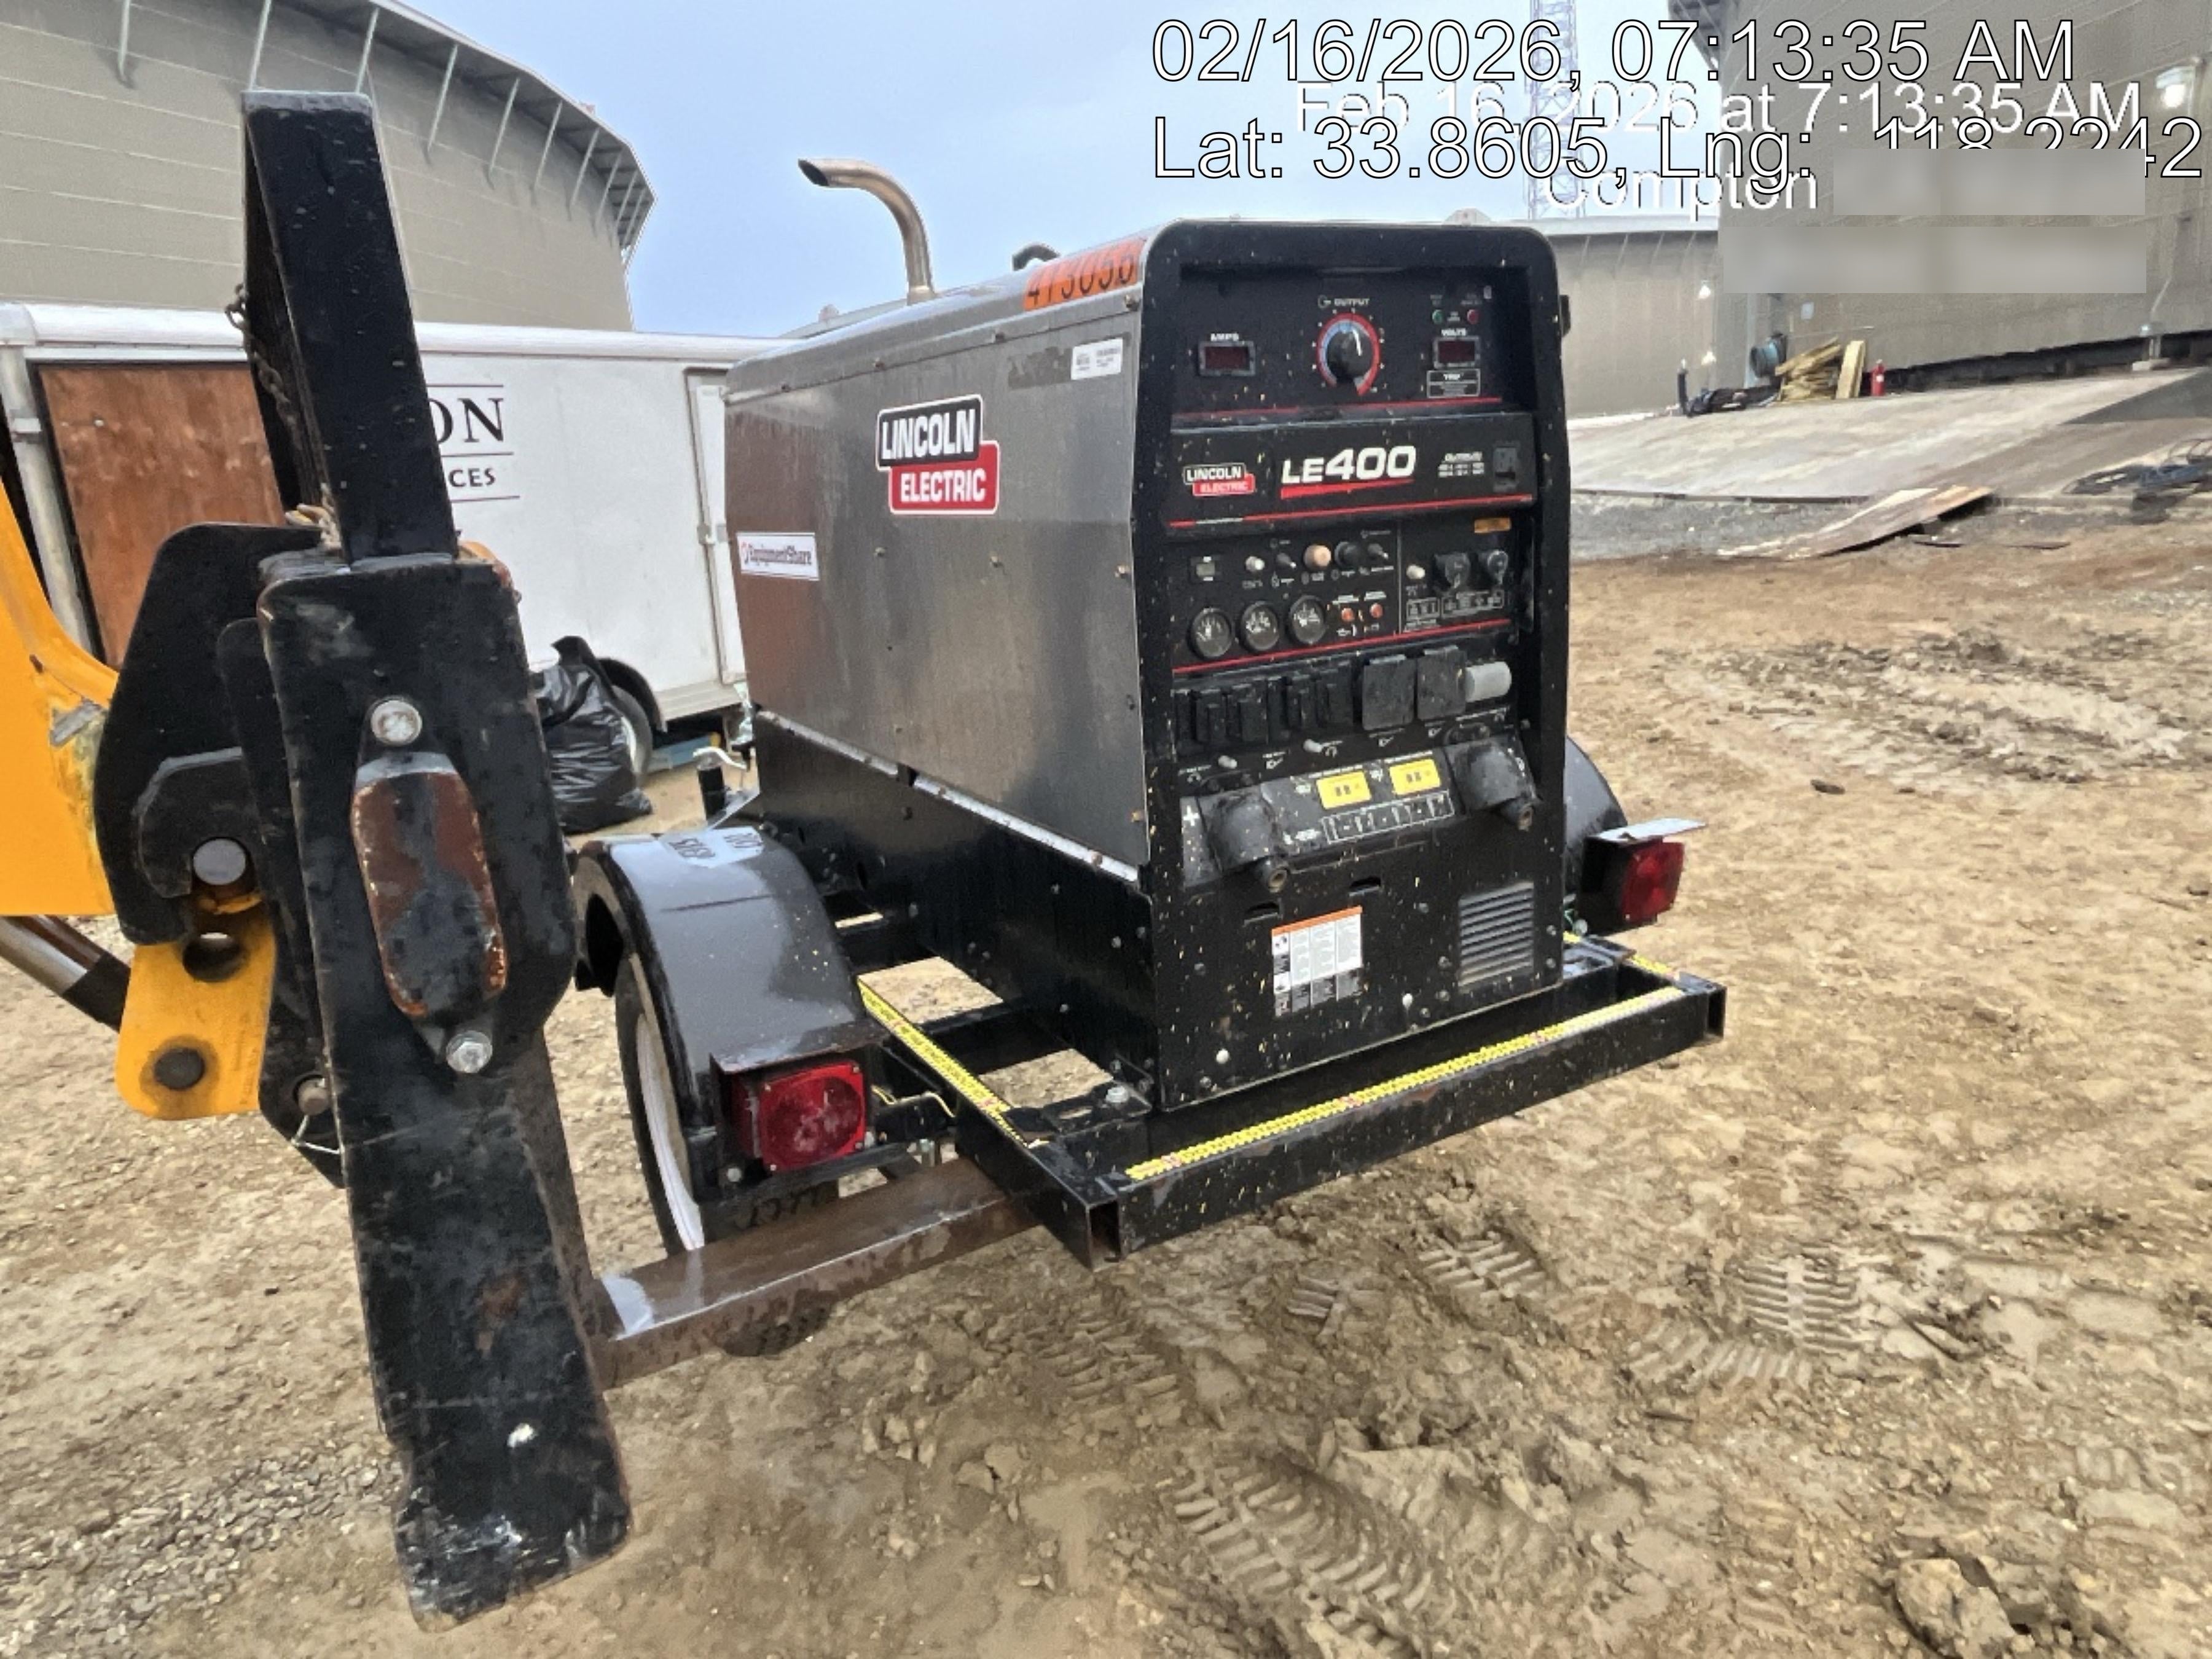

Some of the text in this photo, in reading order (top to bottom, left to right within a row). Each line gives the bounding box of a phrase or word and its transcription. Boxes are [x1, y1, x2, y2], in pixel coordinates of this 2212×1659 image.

[1333, 297, 1370, 307] OUTPUT
[881, 408, 976, 460] LINCOLN
[1186, 465, 1242, 481] LINCOLN
[1282, 445, 1416, 484] LE400
[900, 468, 986, 503] ELECTRIC
[1199, 480, 1250, 493] ELECTRIC
